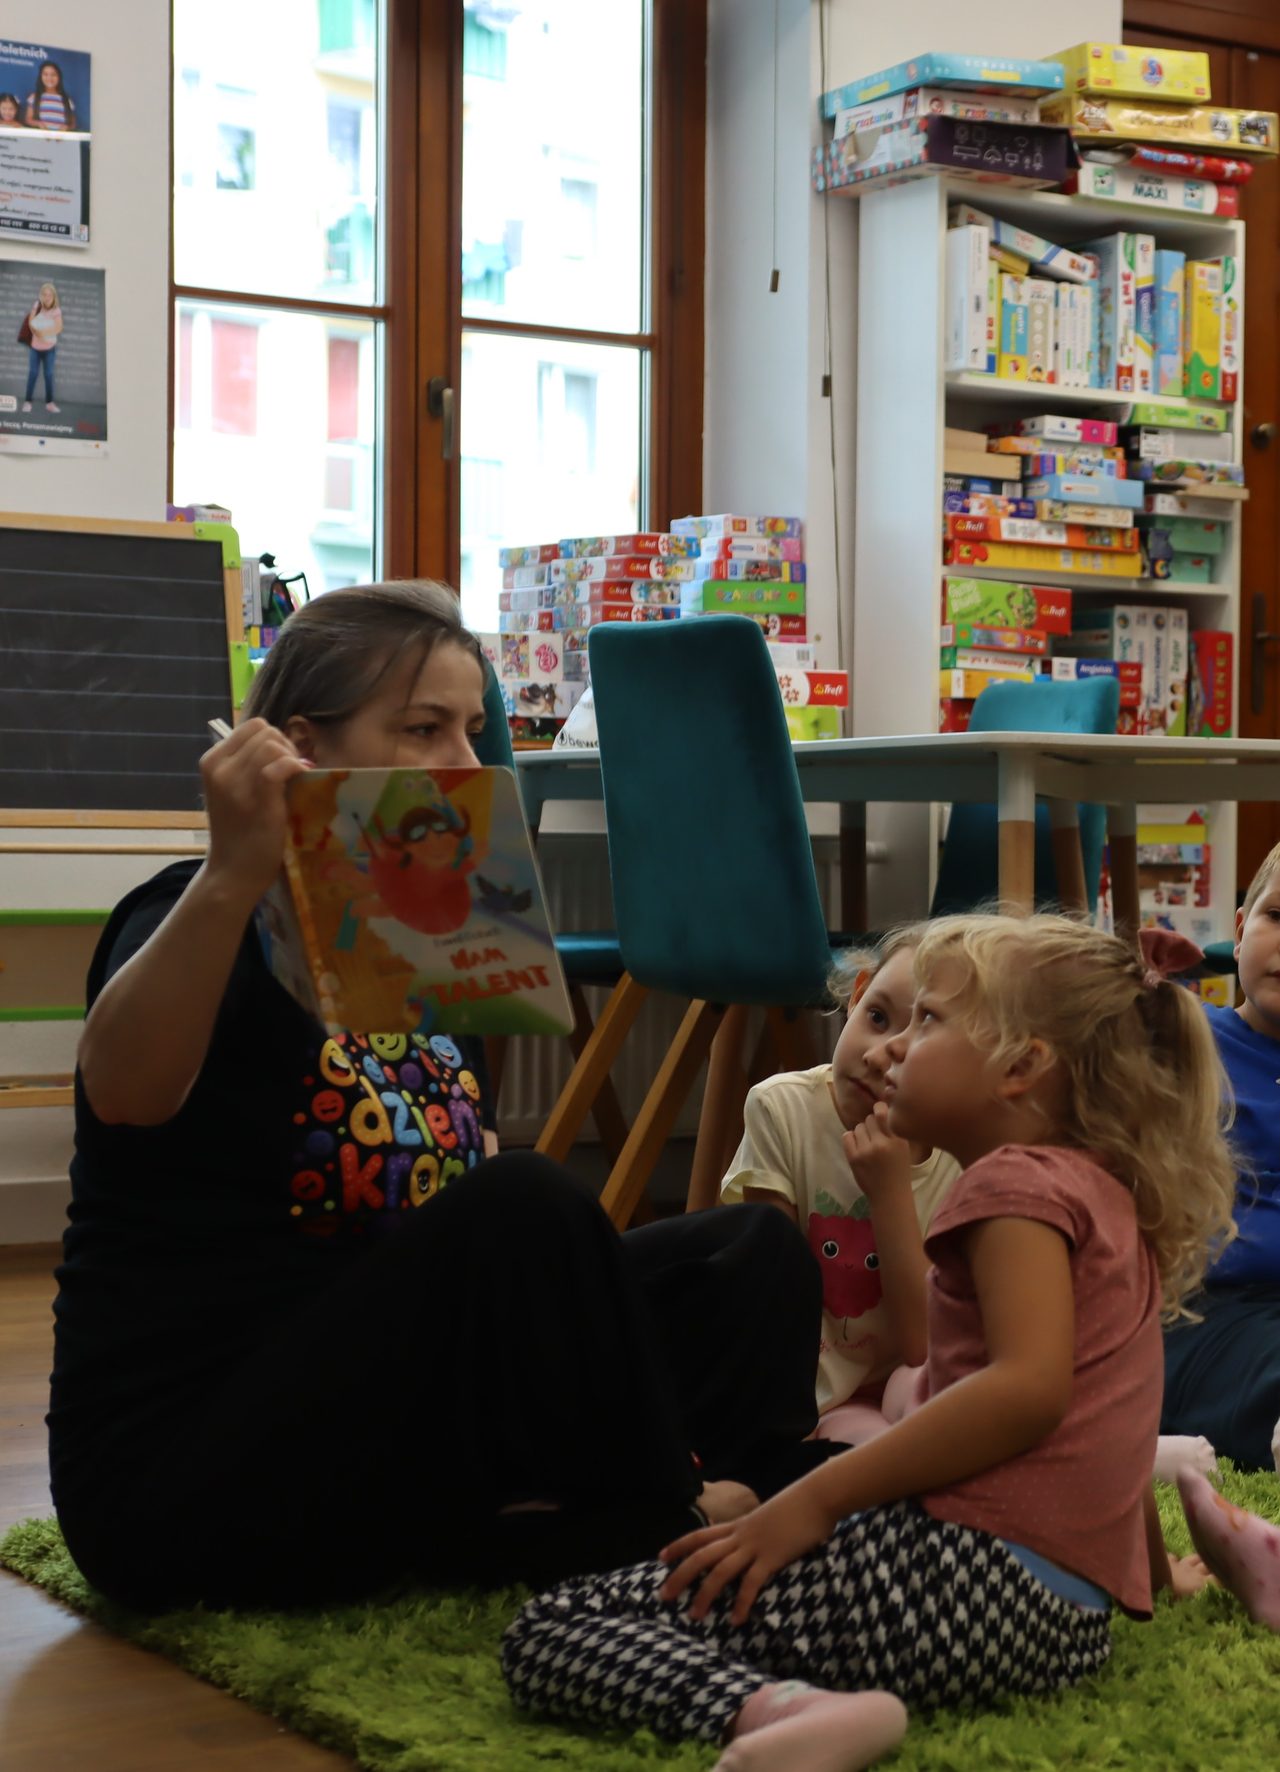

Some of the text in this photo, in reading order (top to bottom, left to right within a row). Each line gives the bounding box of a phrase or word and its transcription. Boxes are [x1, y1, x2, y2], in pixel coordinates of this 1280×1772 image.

[1133, 182, 1169, 200] MAXI
[965, 520, 986, 532] Trefl
[1049, 606, 1067, 617] Trefl
[823, 683, 844, 696] Trefl
[1215, 641, 1228, 727] BIZNES
[450, 947, 508, 971] MAM
[421, 964, 551, 1007] TALENT
